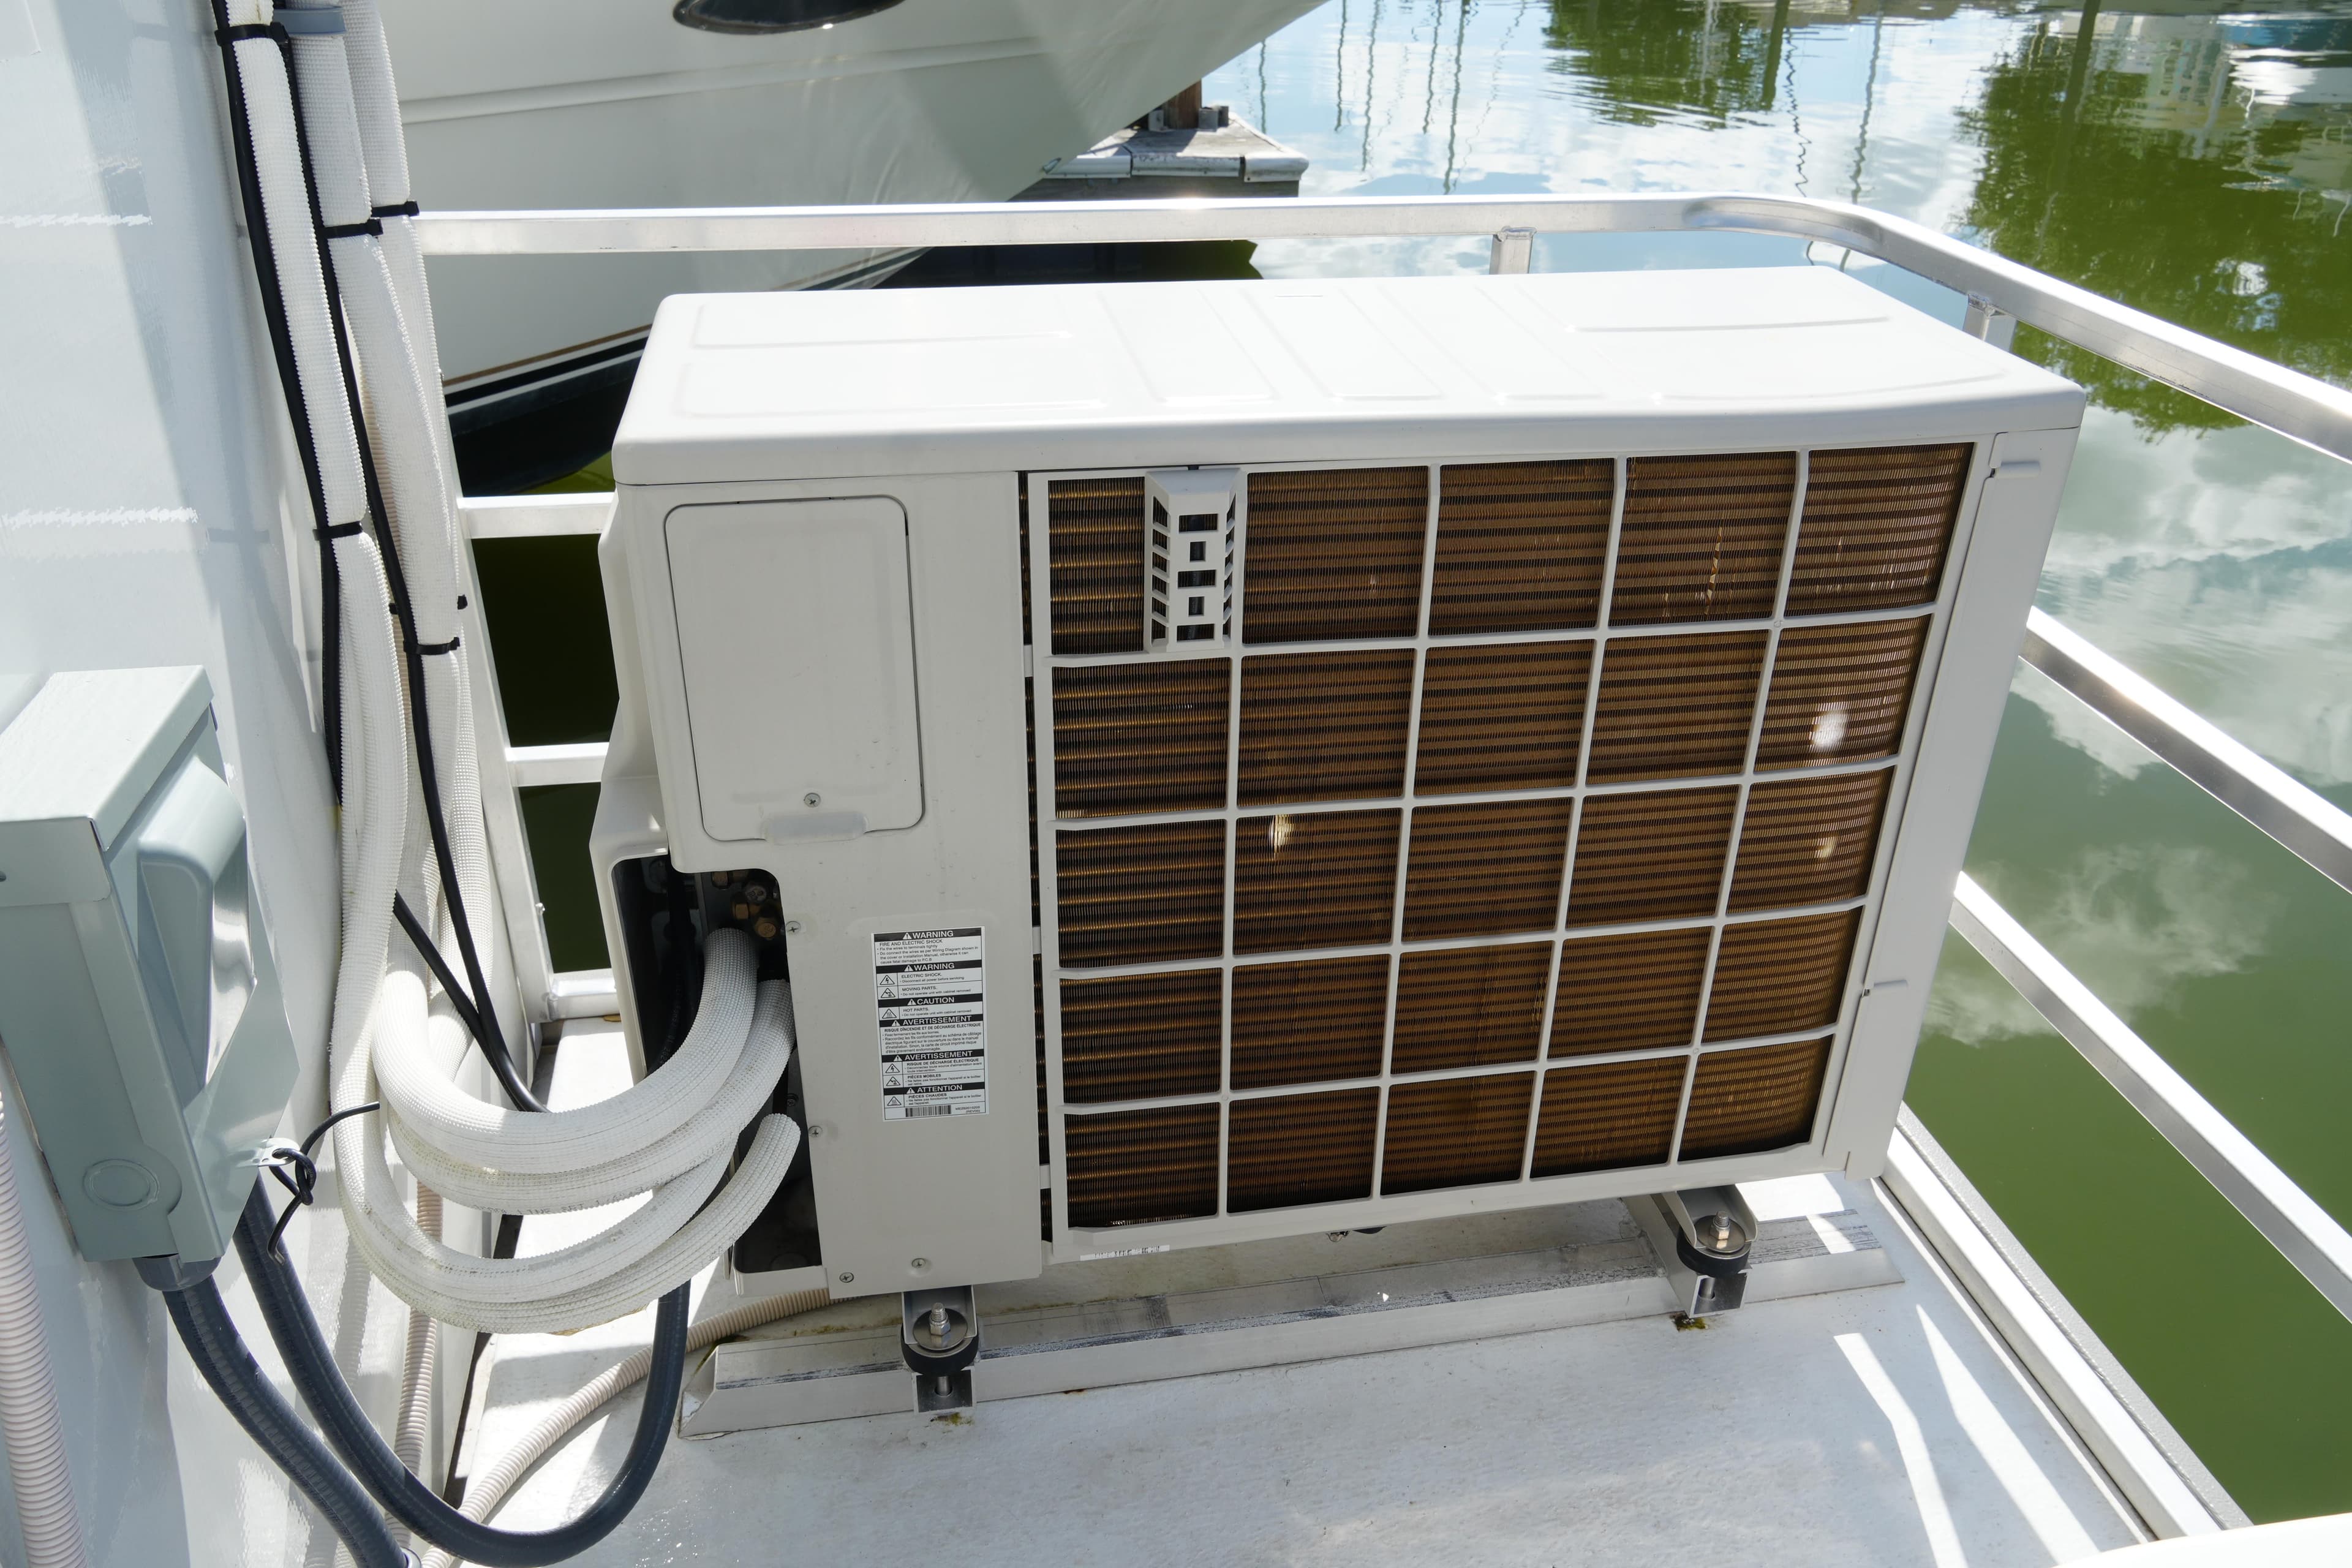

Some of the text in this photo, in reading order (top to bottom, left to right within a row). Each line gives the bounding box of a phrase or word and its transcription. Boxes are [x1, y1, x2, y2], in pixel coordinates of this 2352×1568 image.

[912, 930, 954, 939] WARNING
[917, 997, 954, 1005] CAUTION
[903, 1016, 972, 1026] AVERTISSEMENT
[905, 1050, 973, 1061] AVERTISSEMENT
